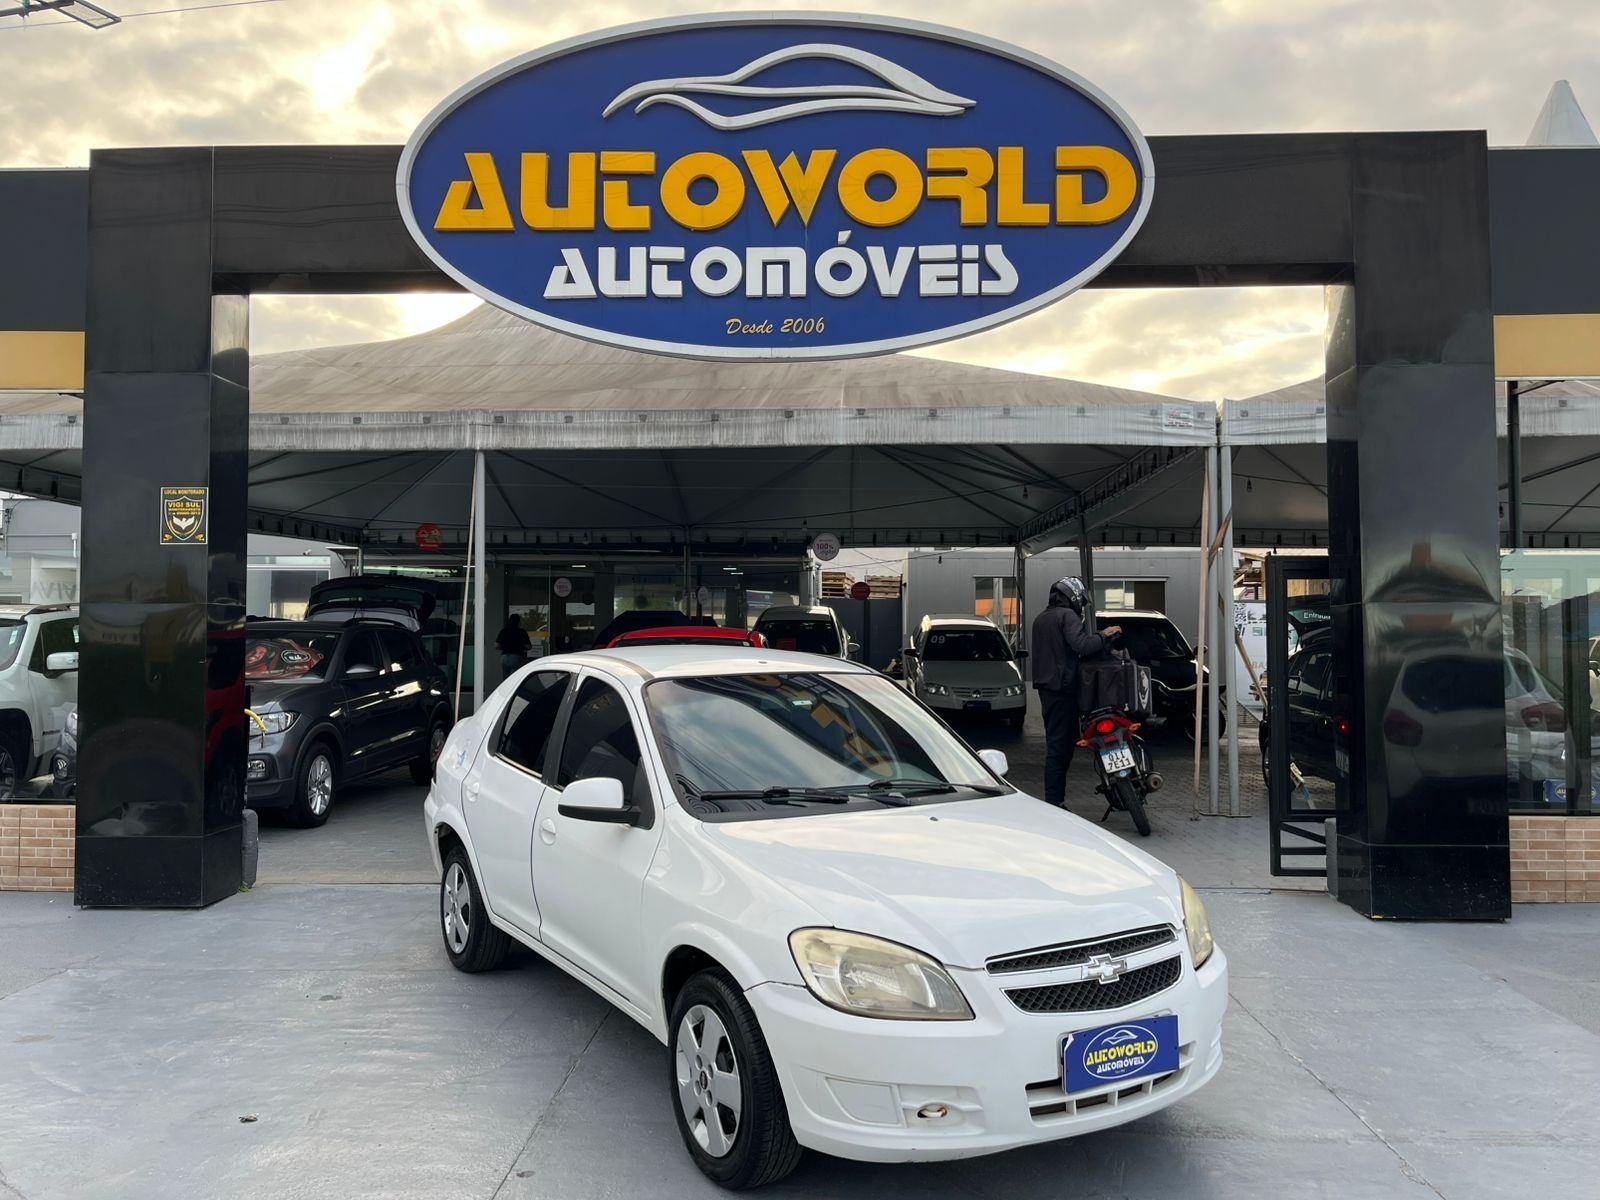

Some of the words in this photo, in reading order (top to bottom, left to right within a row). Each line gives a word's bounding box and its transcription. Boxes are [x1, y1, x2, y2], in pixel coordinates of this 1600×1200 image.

[434, 145, 1137, 232] AUTOWORLD
[543, 229, 1020, 299] AUTOMÓVEIS
[725, 317, 773, 335] Desde
[780, 316, 826, 334] 2006
[1086, 1040, 1156, 1066] AUTOWORLD
[1096, 1056, 1145, 1074] AUTOMÓVEIS
